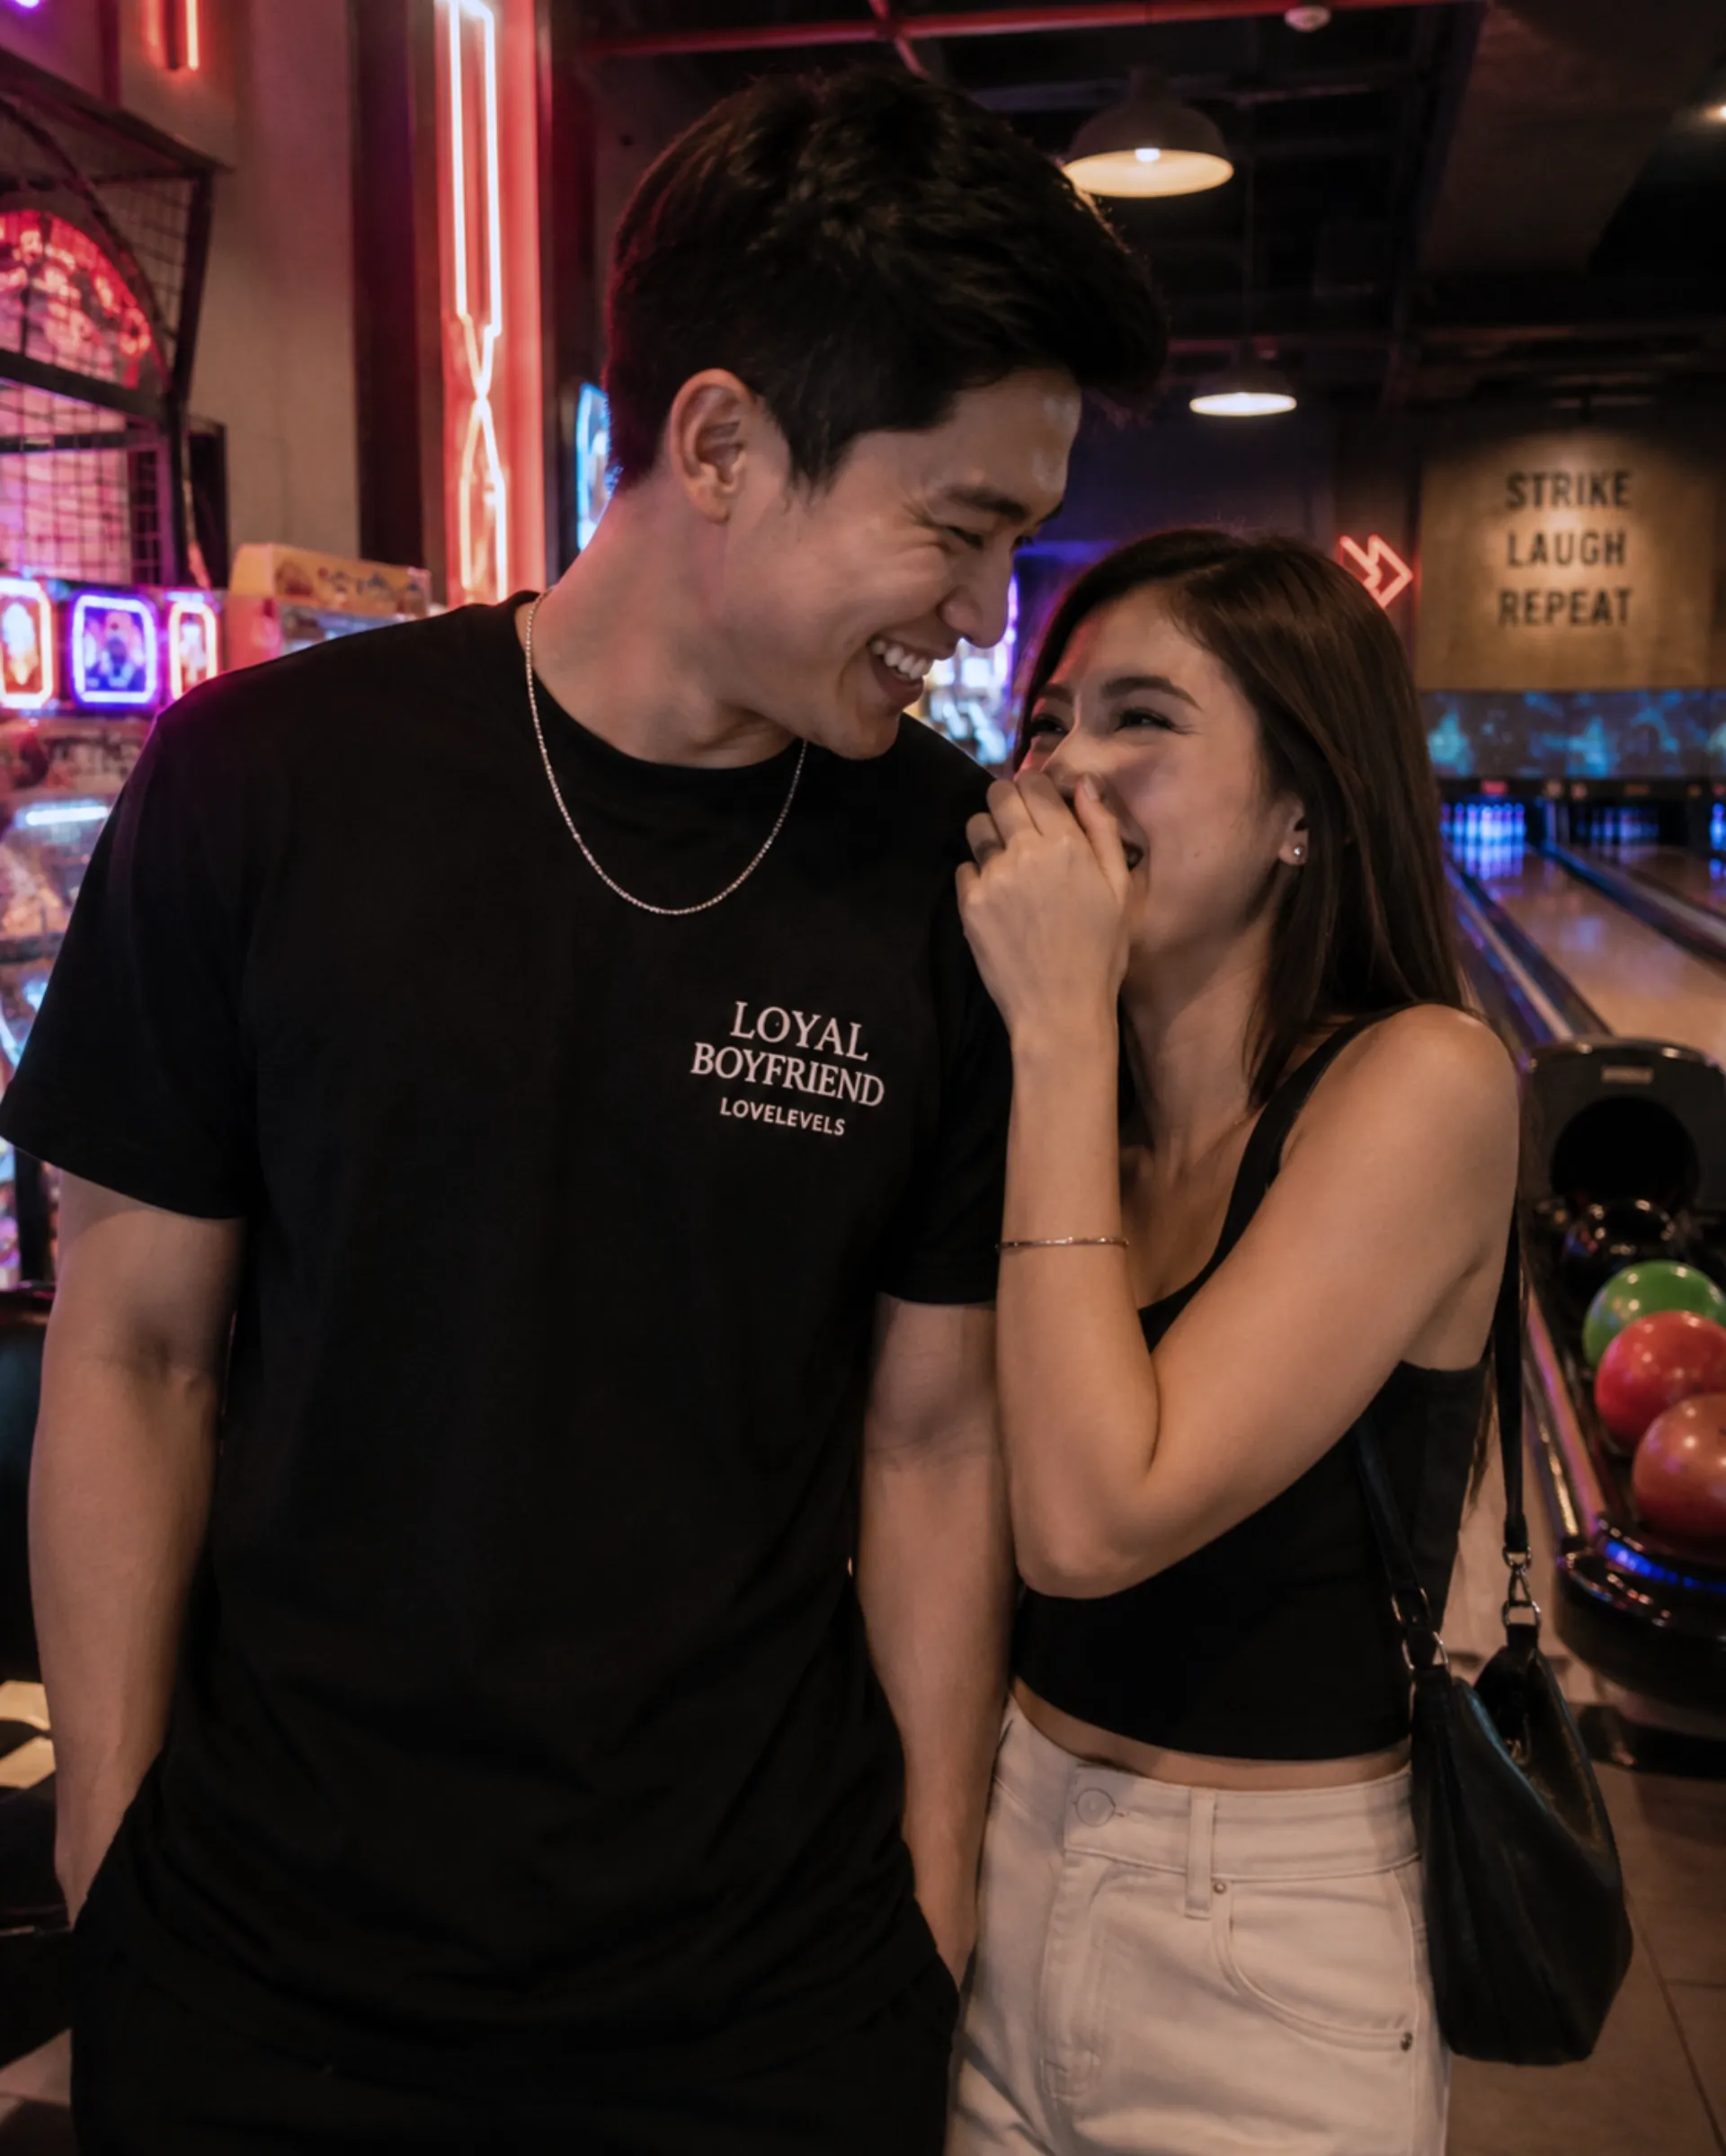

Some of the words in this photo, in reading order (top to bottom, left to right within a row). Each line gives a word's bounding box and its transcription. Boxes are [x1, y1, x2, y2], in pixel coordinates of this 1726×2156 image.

[1506, 470, 1631, 510] STRIKE
[1507, 529, 1626, 567] LAUGH
[1499, 587, 1633, 626] REPEAT
[730, 1000, 869, 1061] LOYAL
[690, 1042, 885, 1107] BOYFRIEND
[719, 1097, 846, 1136] LOVELEVELS
